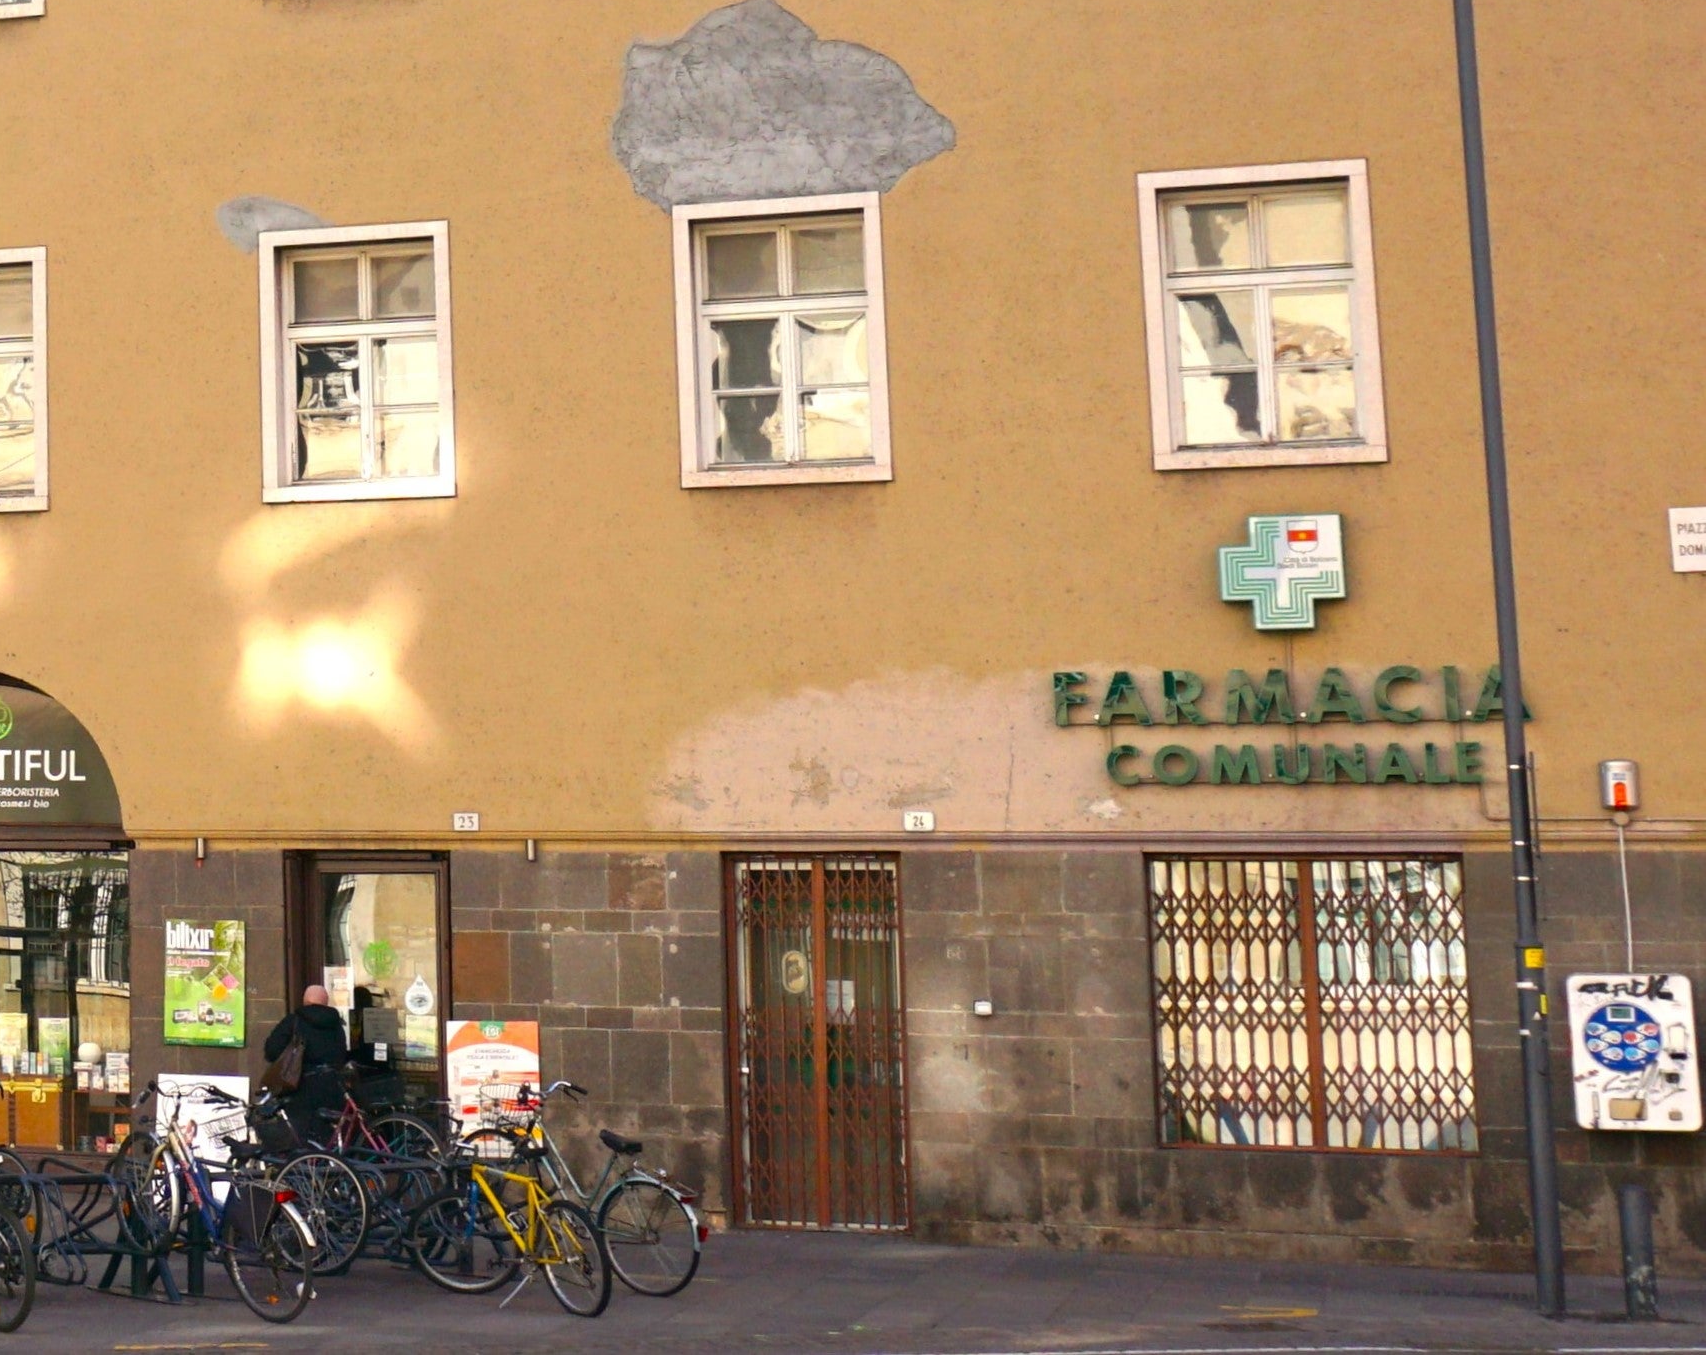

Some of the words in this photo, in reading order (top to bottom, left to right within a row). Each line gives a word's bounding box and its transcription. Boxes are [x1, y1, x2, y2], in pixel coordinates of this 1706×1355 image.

[1053, 664, 1533, 727] FARMACIA
[1105, 741, 1484, 786] COMUNALE
[33, 798, 50, 808] bio
